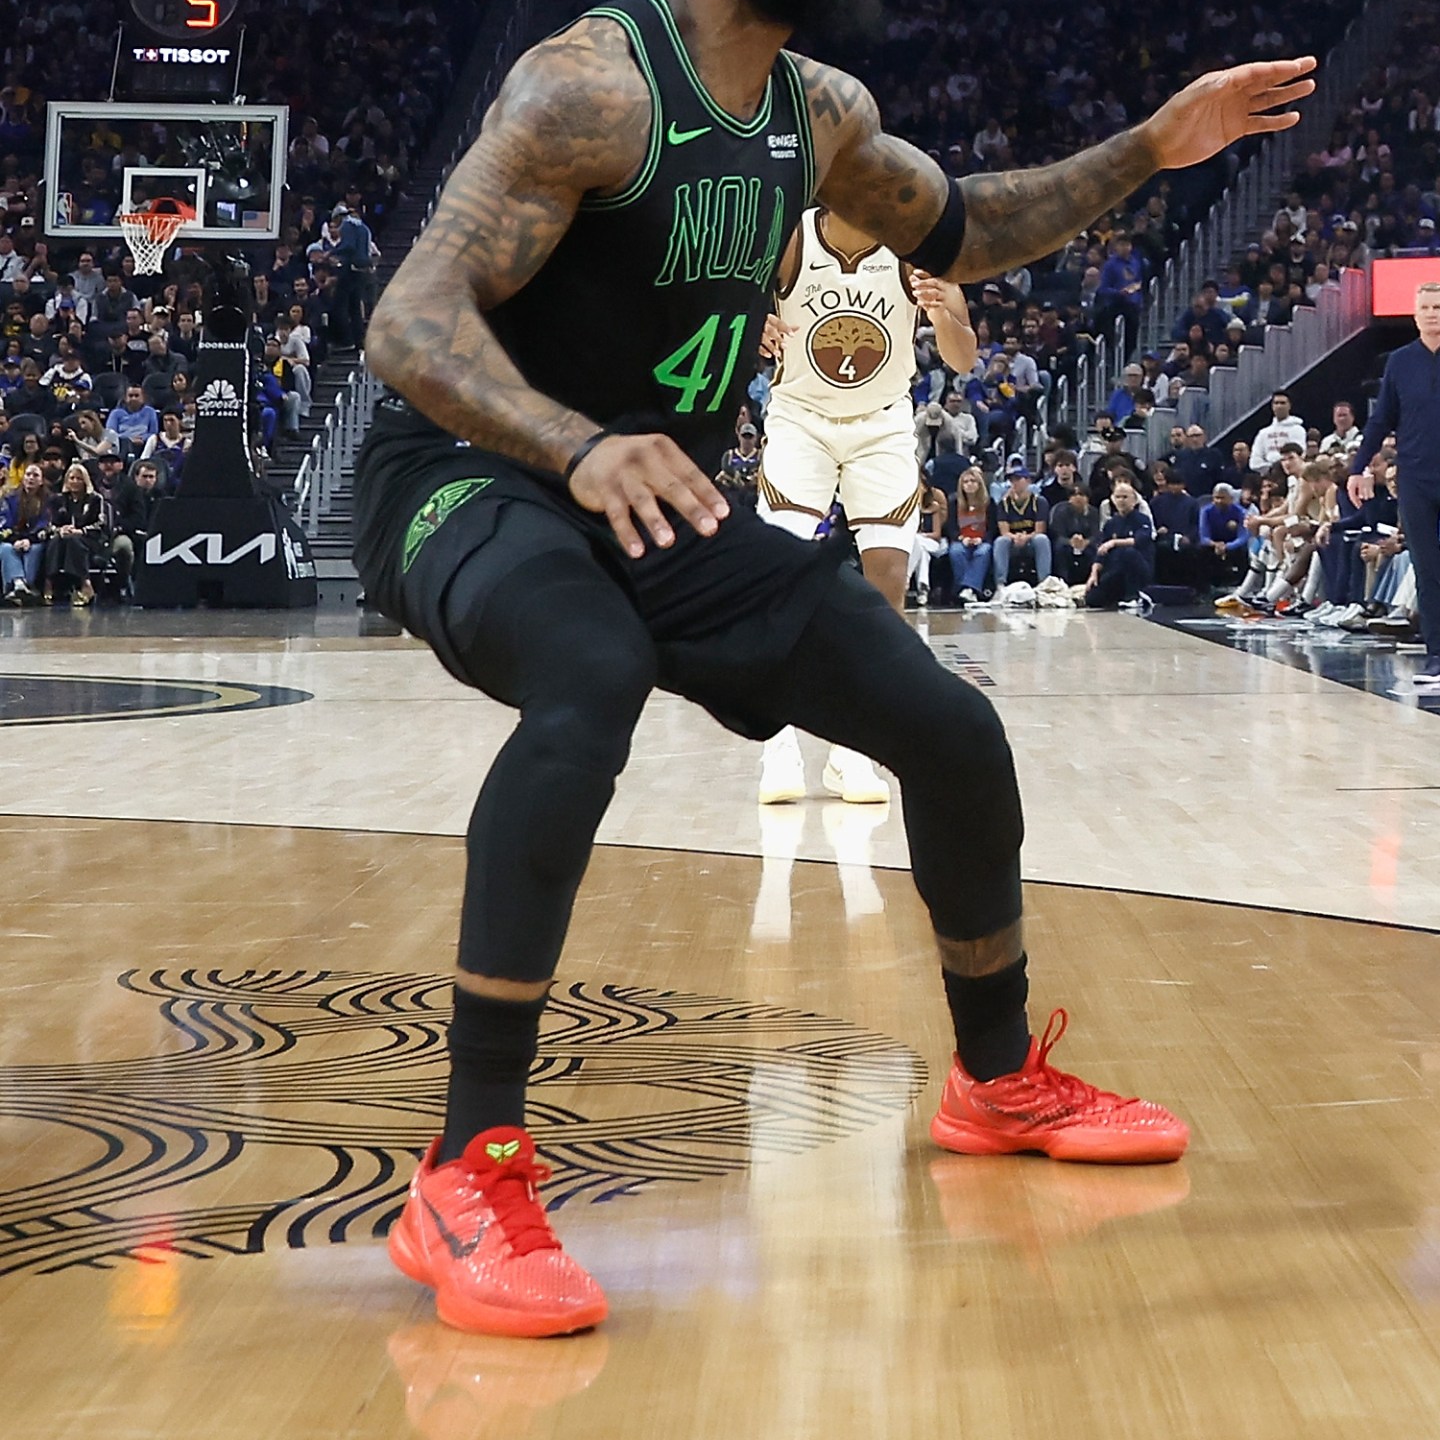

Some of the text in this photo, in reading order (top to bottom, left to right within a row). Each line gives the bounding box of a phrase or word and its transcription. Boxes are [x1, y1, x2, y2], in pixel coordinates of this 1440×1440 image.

[159, 47, 230, 64] TISSOT
[654, 175, 785, 294] NOLA
[862, 263, 893, 273] Rakuten
[804, 282, 823, 298] The
[800, 287, 895, 321] TOWN
[653, 314, 747, 413] 41
[838, 354, 856, 381] 4
